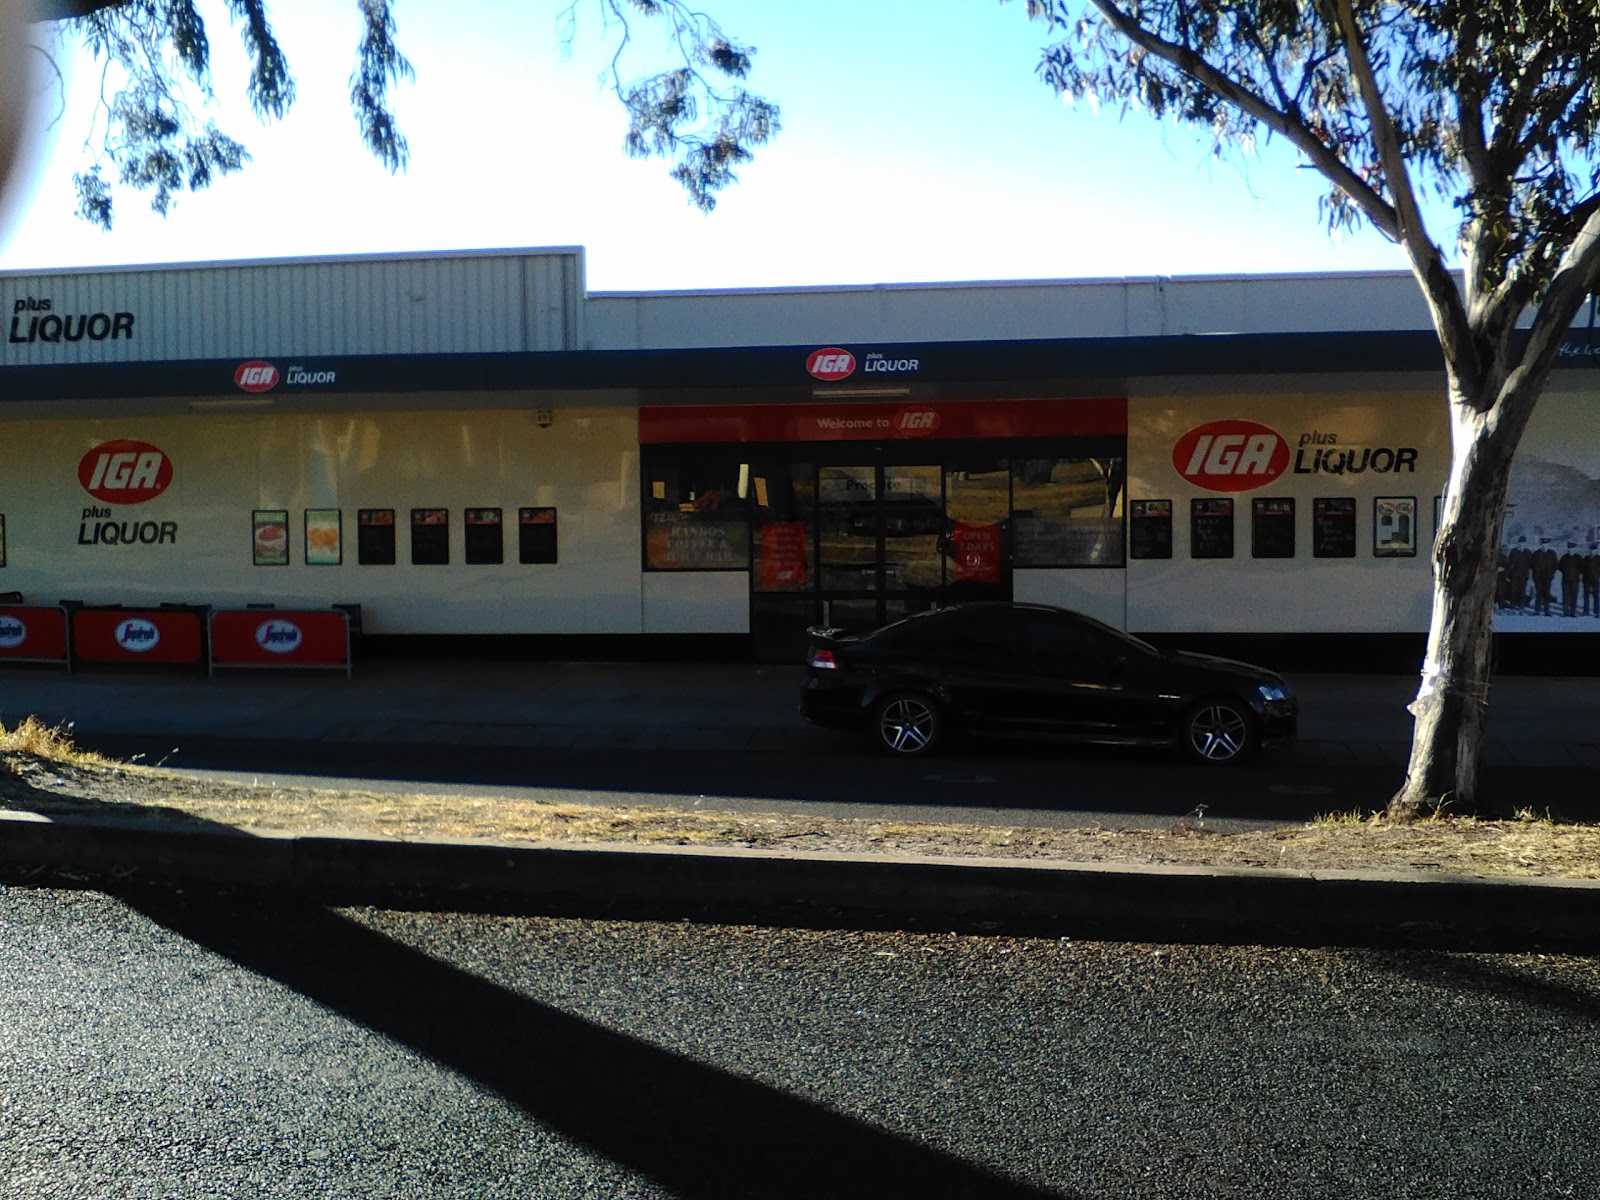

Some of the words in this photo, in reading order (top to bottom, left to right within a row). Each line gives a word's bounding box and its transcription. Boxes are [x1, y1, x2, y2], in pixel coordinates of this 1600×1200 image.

[14, 296, 52, 314] plus
[9, 312, 135, 343] LIQUOR
[812, 354, 851, 373] IGA
[864, 359, 920, 372] LIQUOR
[240, 366, 276, 385] IGA
[286, 371, 336, 384] LIQUOR
[816, 418, 873, 429] Welcome
[876, 418, 890, 428] to
[900, 412, 936, 429] IGA
[1299, 430, 1337, 447] plus
[1185, 434, 1279, 475] IGA
[1293, 447, 1419, 476] LIQUOR
[88, 452, 163, 490] IGA
[82, 505, 112, 520] plus
[78, 521, 178, 546] LIQUOR
[963, 531, 991, 541] OPEN
[967, 543, 995, 552] DAYS
